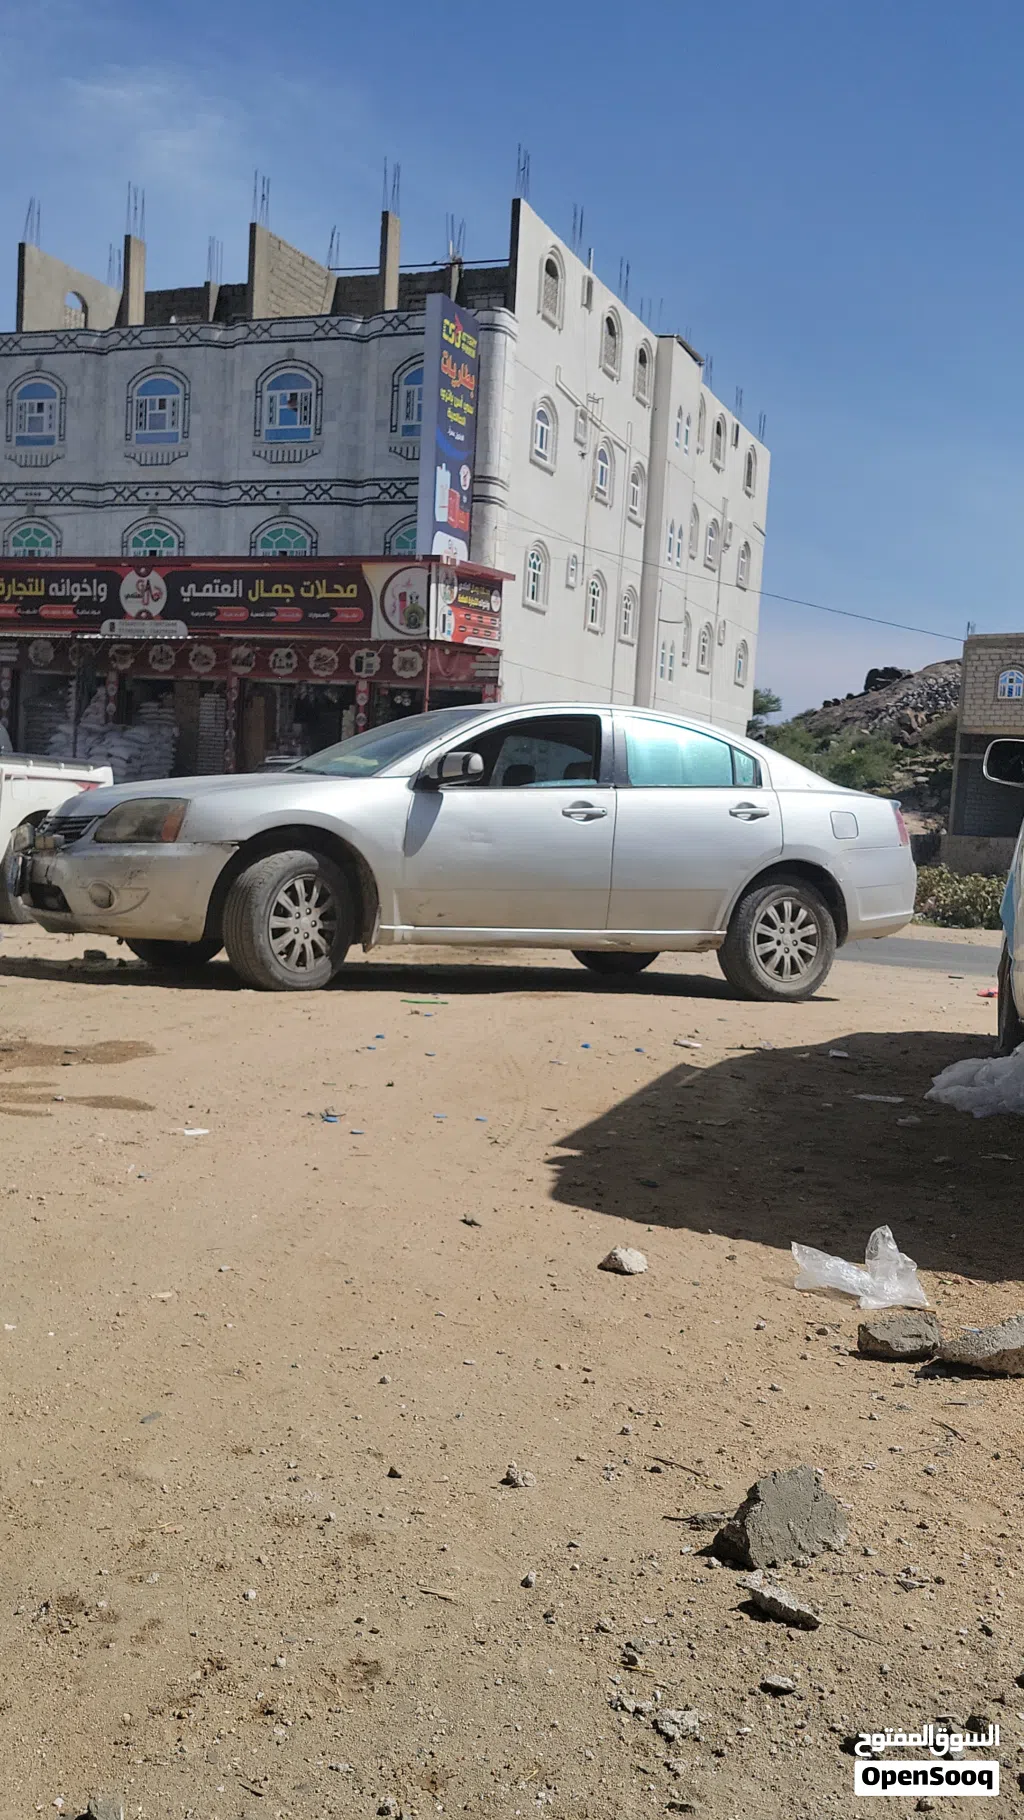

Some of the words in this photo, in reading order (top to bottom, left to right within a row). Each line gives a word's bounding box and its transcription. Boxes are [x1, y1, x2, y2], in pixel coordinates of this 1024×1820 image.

[48, 578, 108, 602] وإخوانه
[180, 579, 243, 603] العتمي
[248, 579, 295, 603] جمال
[300, 580, 358, 600] محلات
